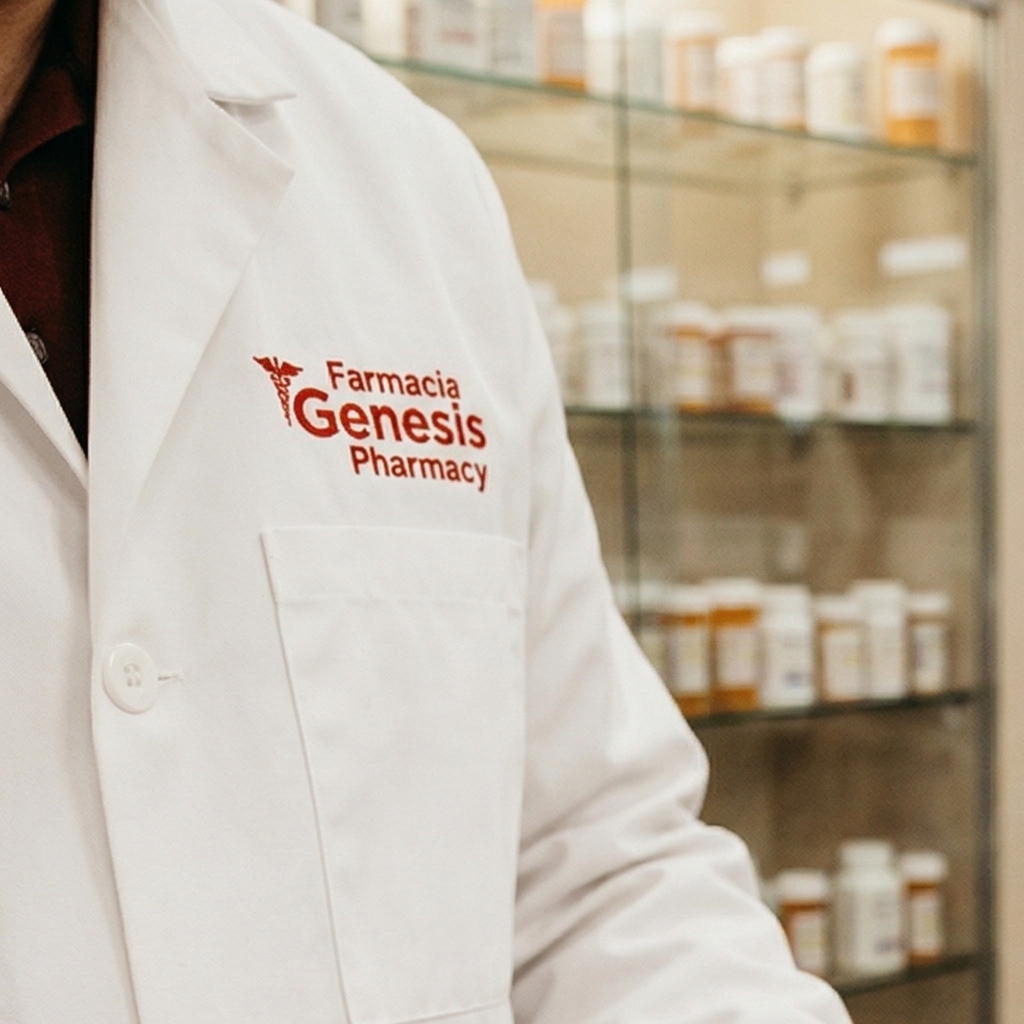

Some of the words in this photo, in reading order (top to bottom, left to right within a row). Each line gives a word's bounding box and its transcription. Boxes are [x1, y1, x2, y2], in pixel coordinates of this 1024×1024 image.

[326, 360, 460, 399] Farmacia
[293, 387, 487, 449] Genesis
[350, 445, 488, 492] Pharmacy
